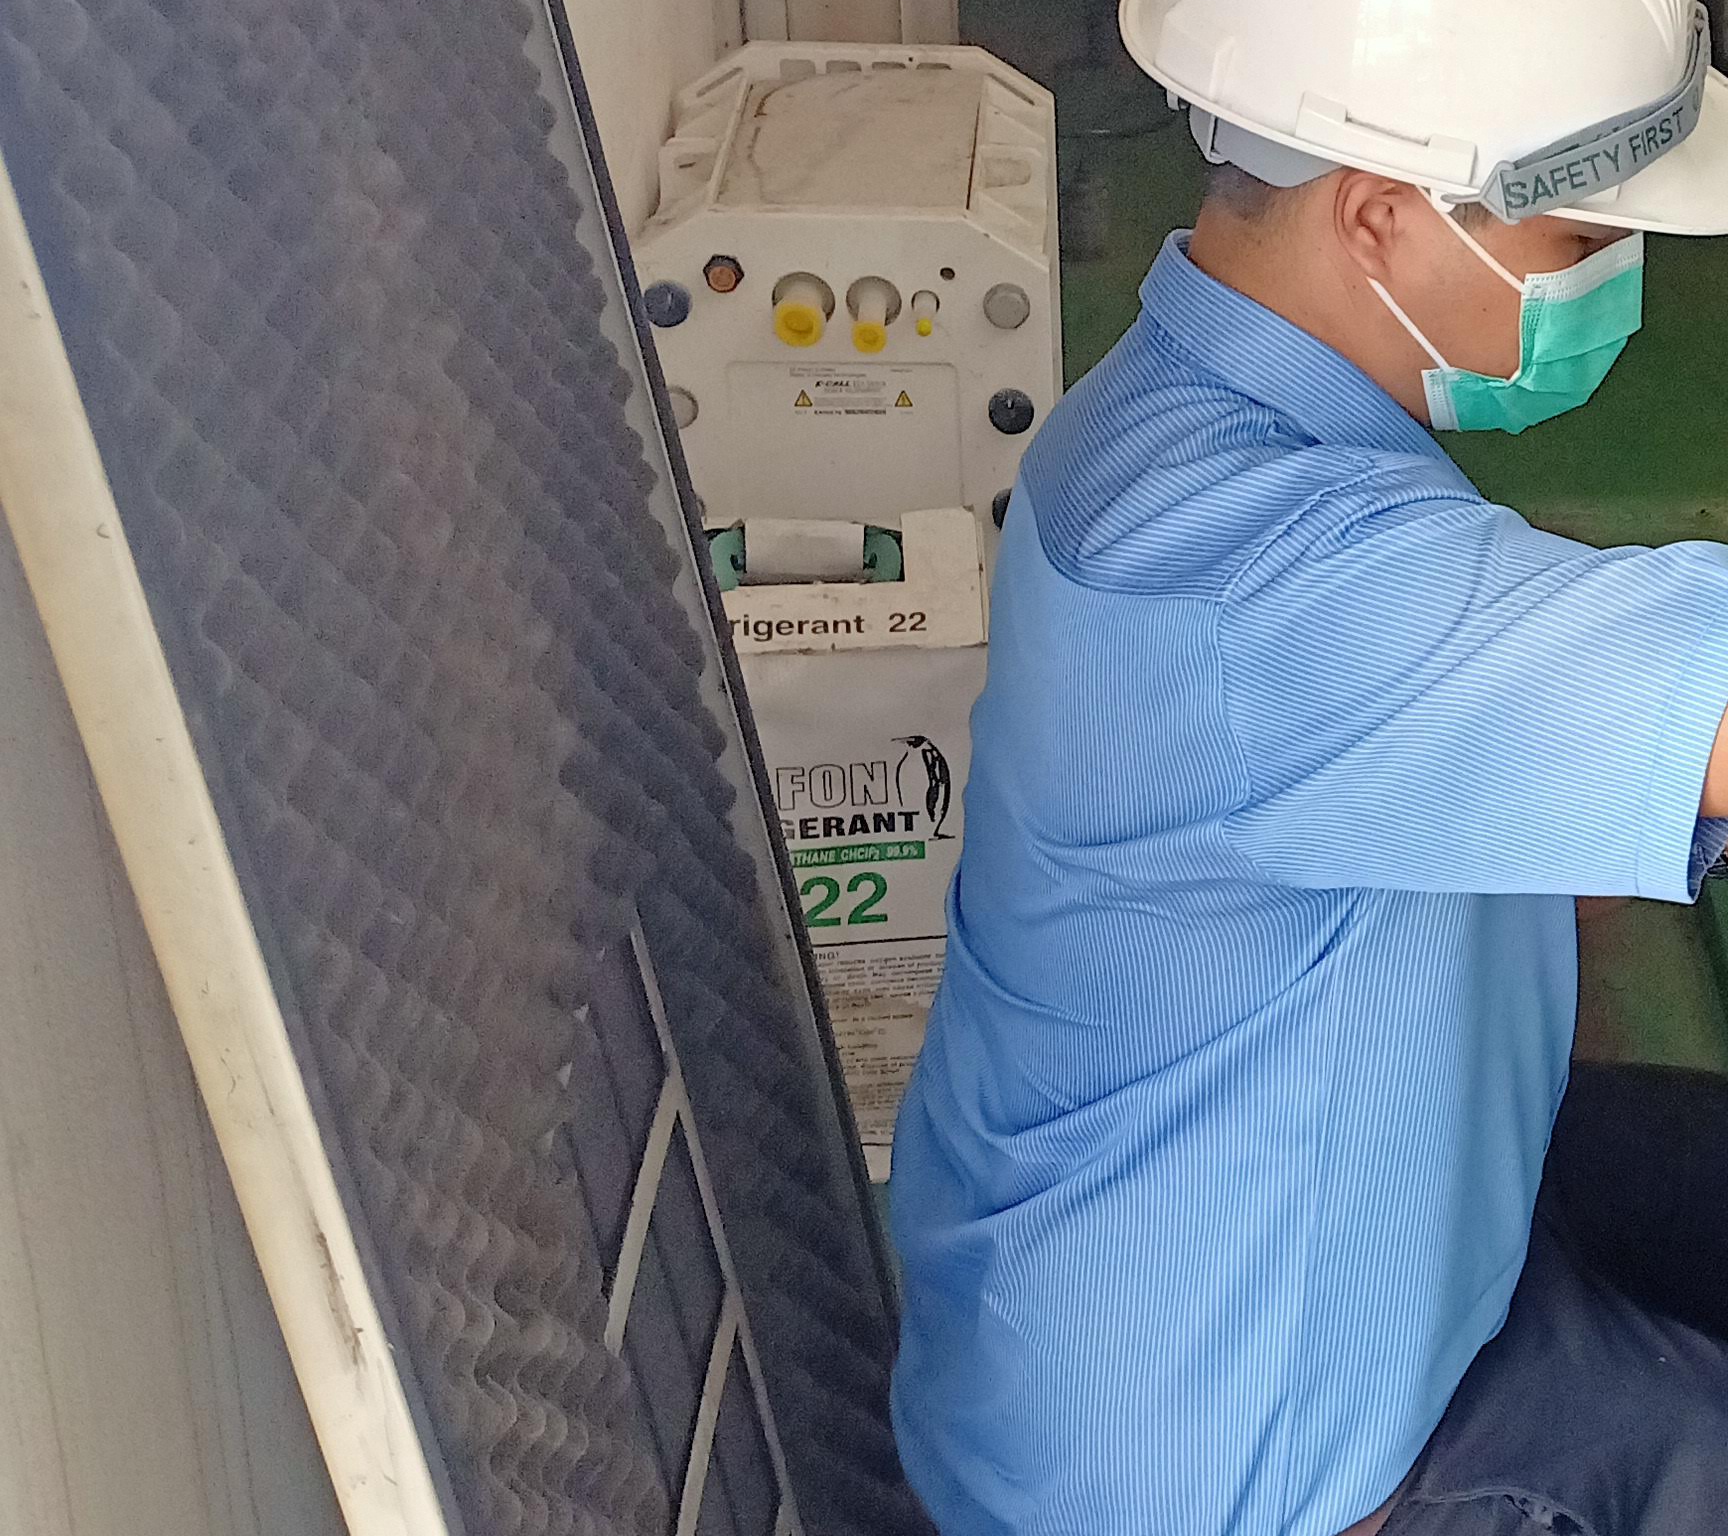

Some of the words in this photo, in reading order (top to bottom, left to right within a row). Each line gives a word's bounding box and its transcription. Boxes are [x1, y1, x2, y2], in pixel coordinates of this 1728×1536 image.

[1505, 144, 1620, 209] SAFETY
[1628, 106, 1684, 163] FIRST
[889, 612, 928, 633] 22
[800, 872, 888, 927] 22
